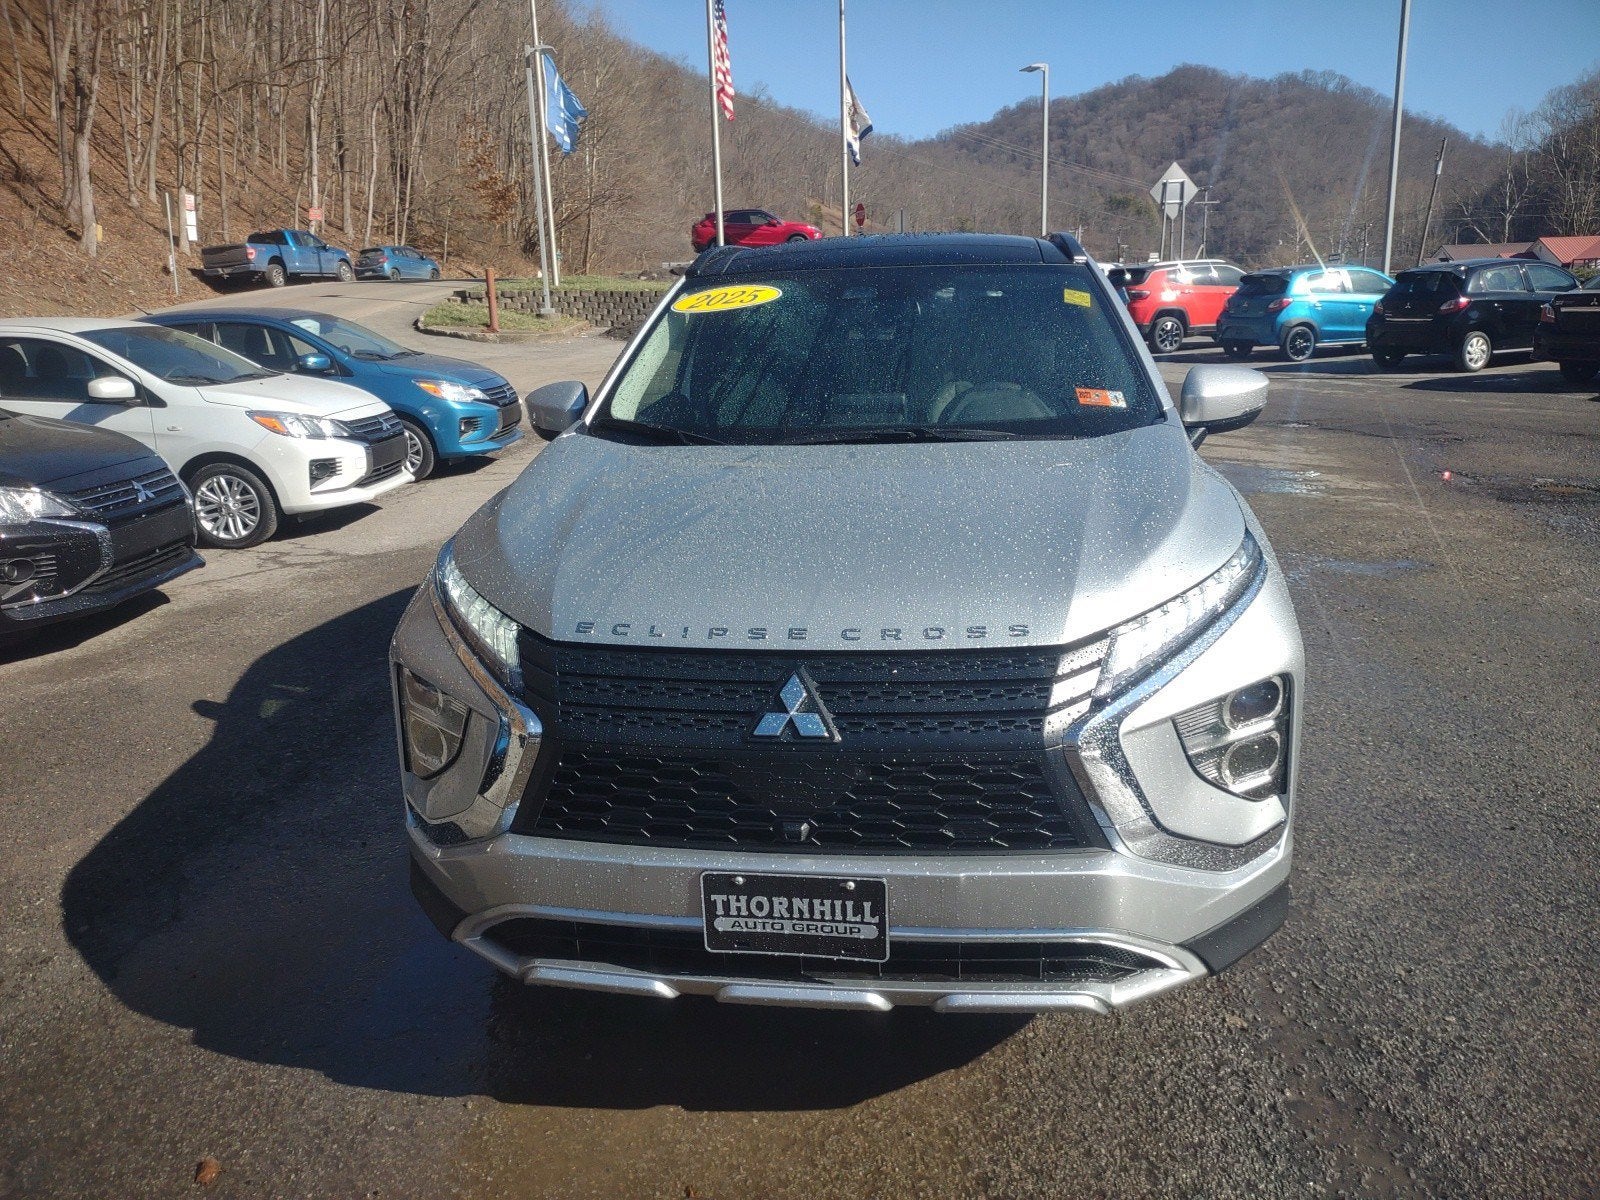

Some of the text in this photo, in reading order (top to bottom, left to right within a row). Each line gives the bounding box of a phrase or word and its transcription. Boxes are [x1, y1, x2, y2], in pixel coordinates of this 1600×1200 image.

[686, 289, 765, 310] 2025
[574, 621, 1030, 641] ECLIPSE CROSS
[711, 894, 880, 924] THORNHILL
[730, 920, 861, 936] AUTO GROUP
